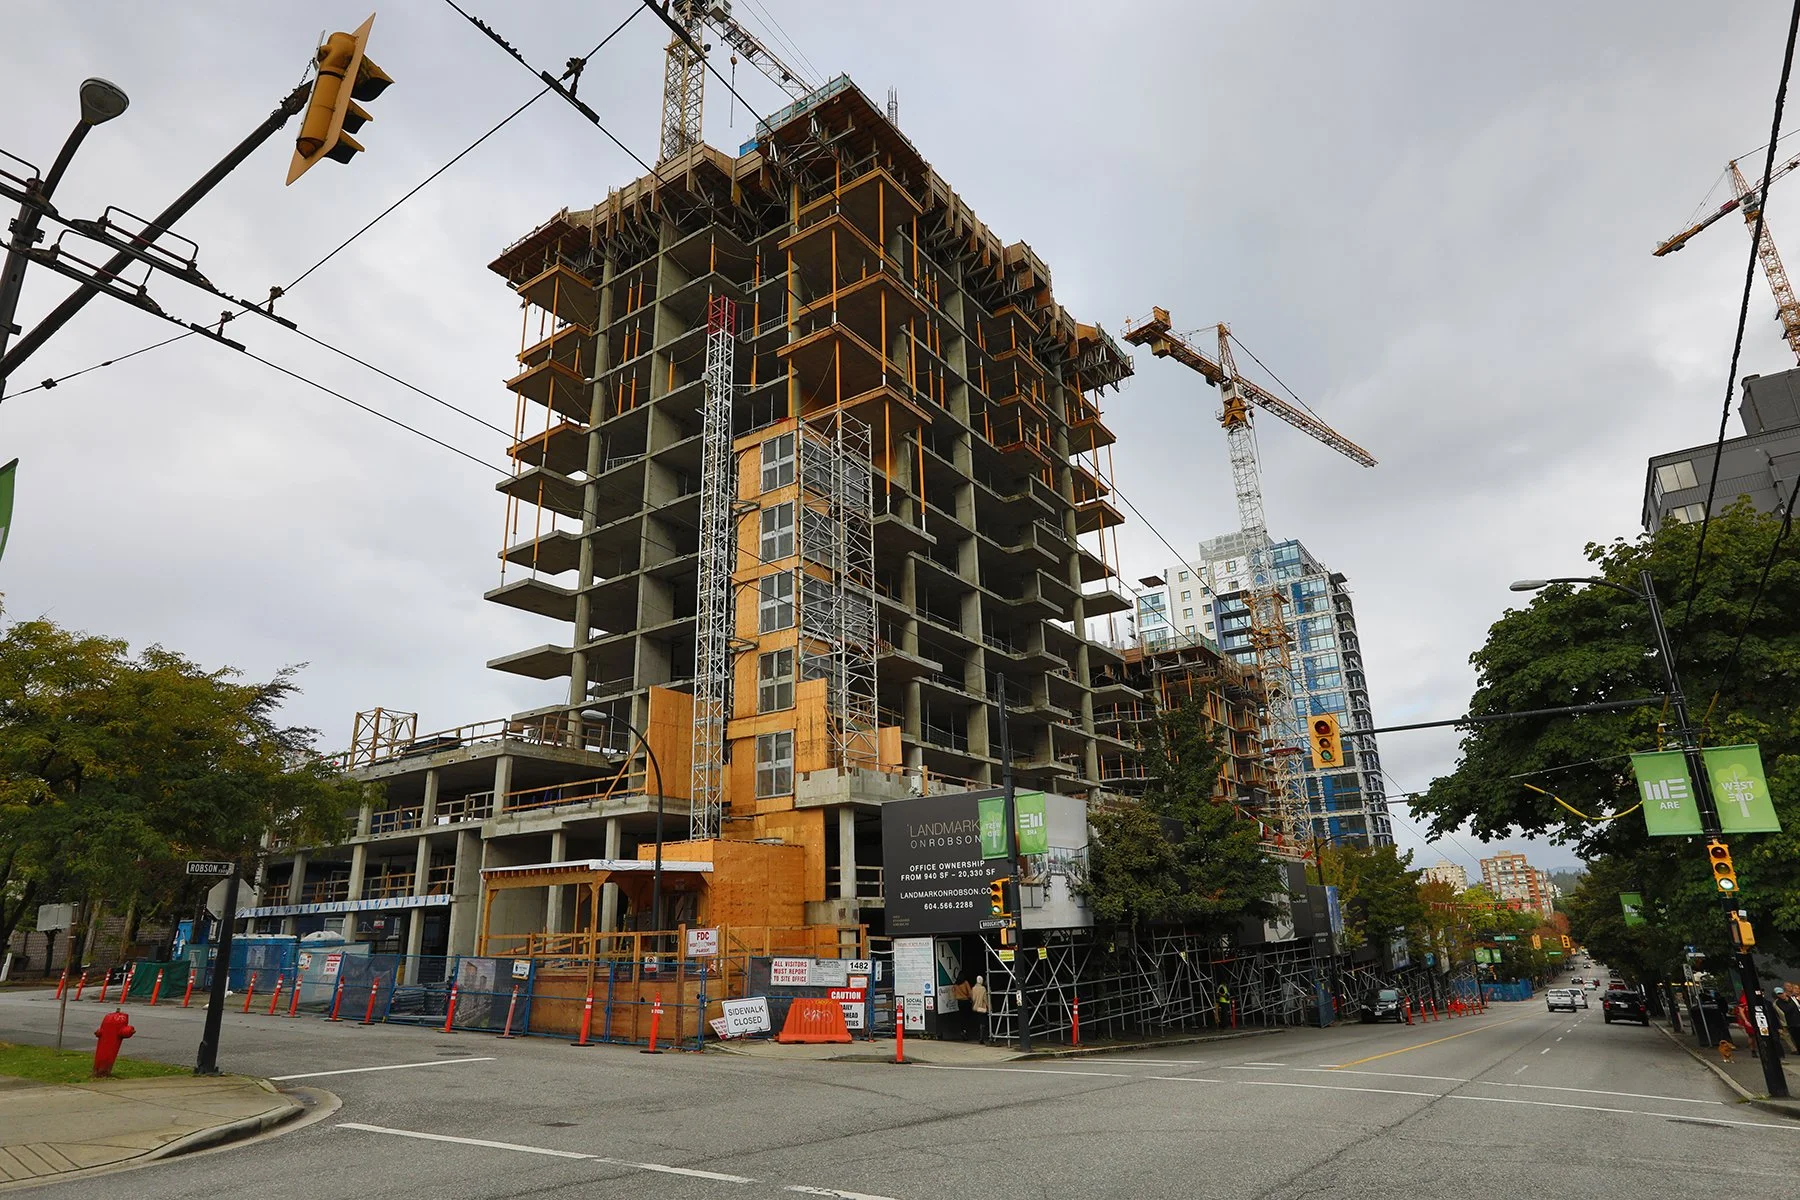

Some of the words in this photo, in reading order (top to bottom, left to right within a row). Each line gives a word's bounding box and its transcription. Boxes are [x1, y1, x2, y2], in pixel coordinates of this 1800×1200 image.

[1643, 778, 1688, 801] WE
[1721, 780, 1754, 791] WEST
[1727, 792, 1754, 802] END
[1660, 801, 1681, 810] ARE
[910, 819, 980, 838] LANDMARK
[190, 864, 218, 873] ROBSON
[909, 863, 936, 872] OFFICE
[939, 860, 985, 870] OWNERSHIP
[901, 873, 922, 881] FROM
[924, 872, 937, 880] 940
[939, 871, 949, 879] SF
[958, 869, 983, 878] 20,330
[986, 868, 996, 876] SF
[900, 887, 992, 900] LANDMARKONROBSON.CO
[924, 901, 973, 910] 604.566.2288
[697, 931, 709, 940] FDC
[850, 962, 869, 970] 1482
[831, 991, 861, 1000] CAUTION
[728, 1005, 764, 1016] SIDEWALK
[734, 1016, 762, 1026] CLOSED
